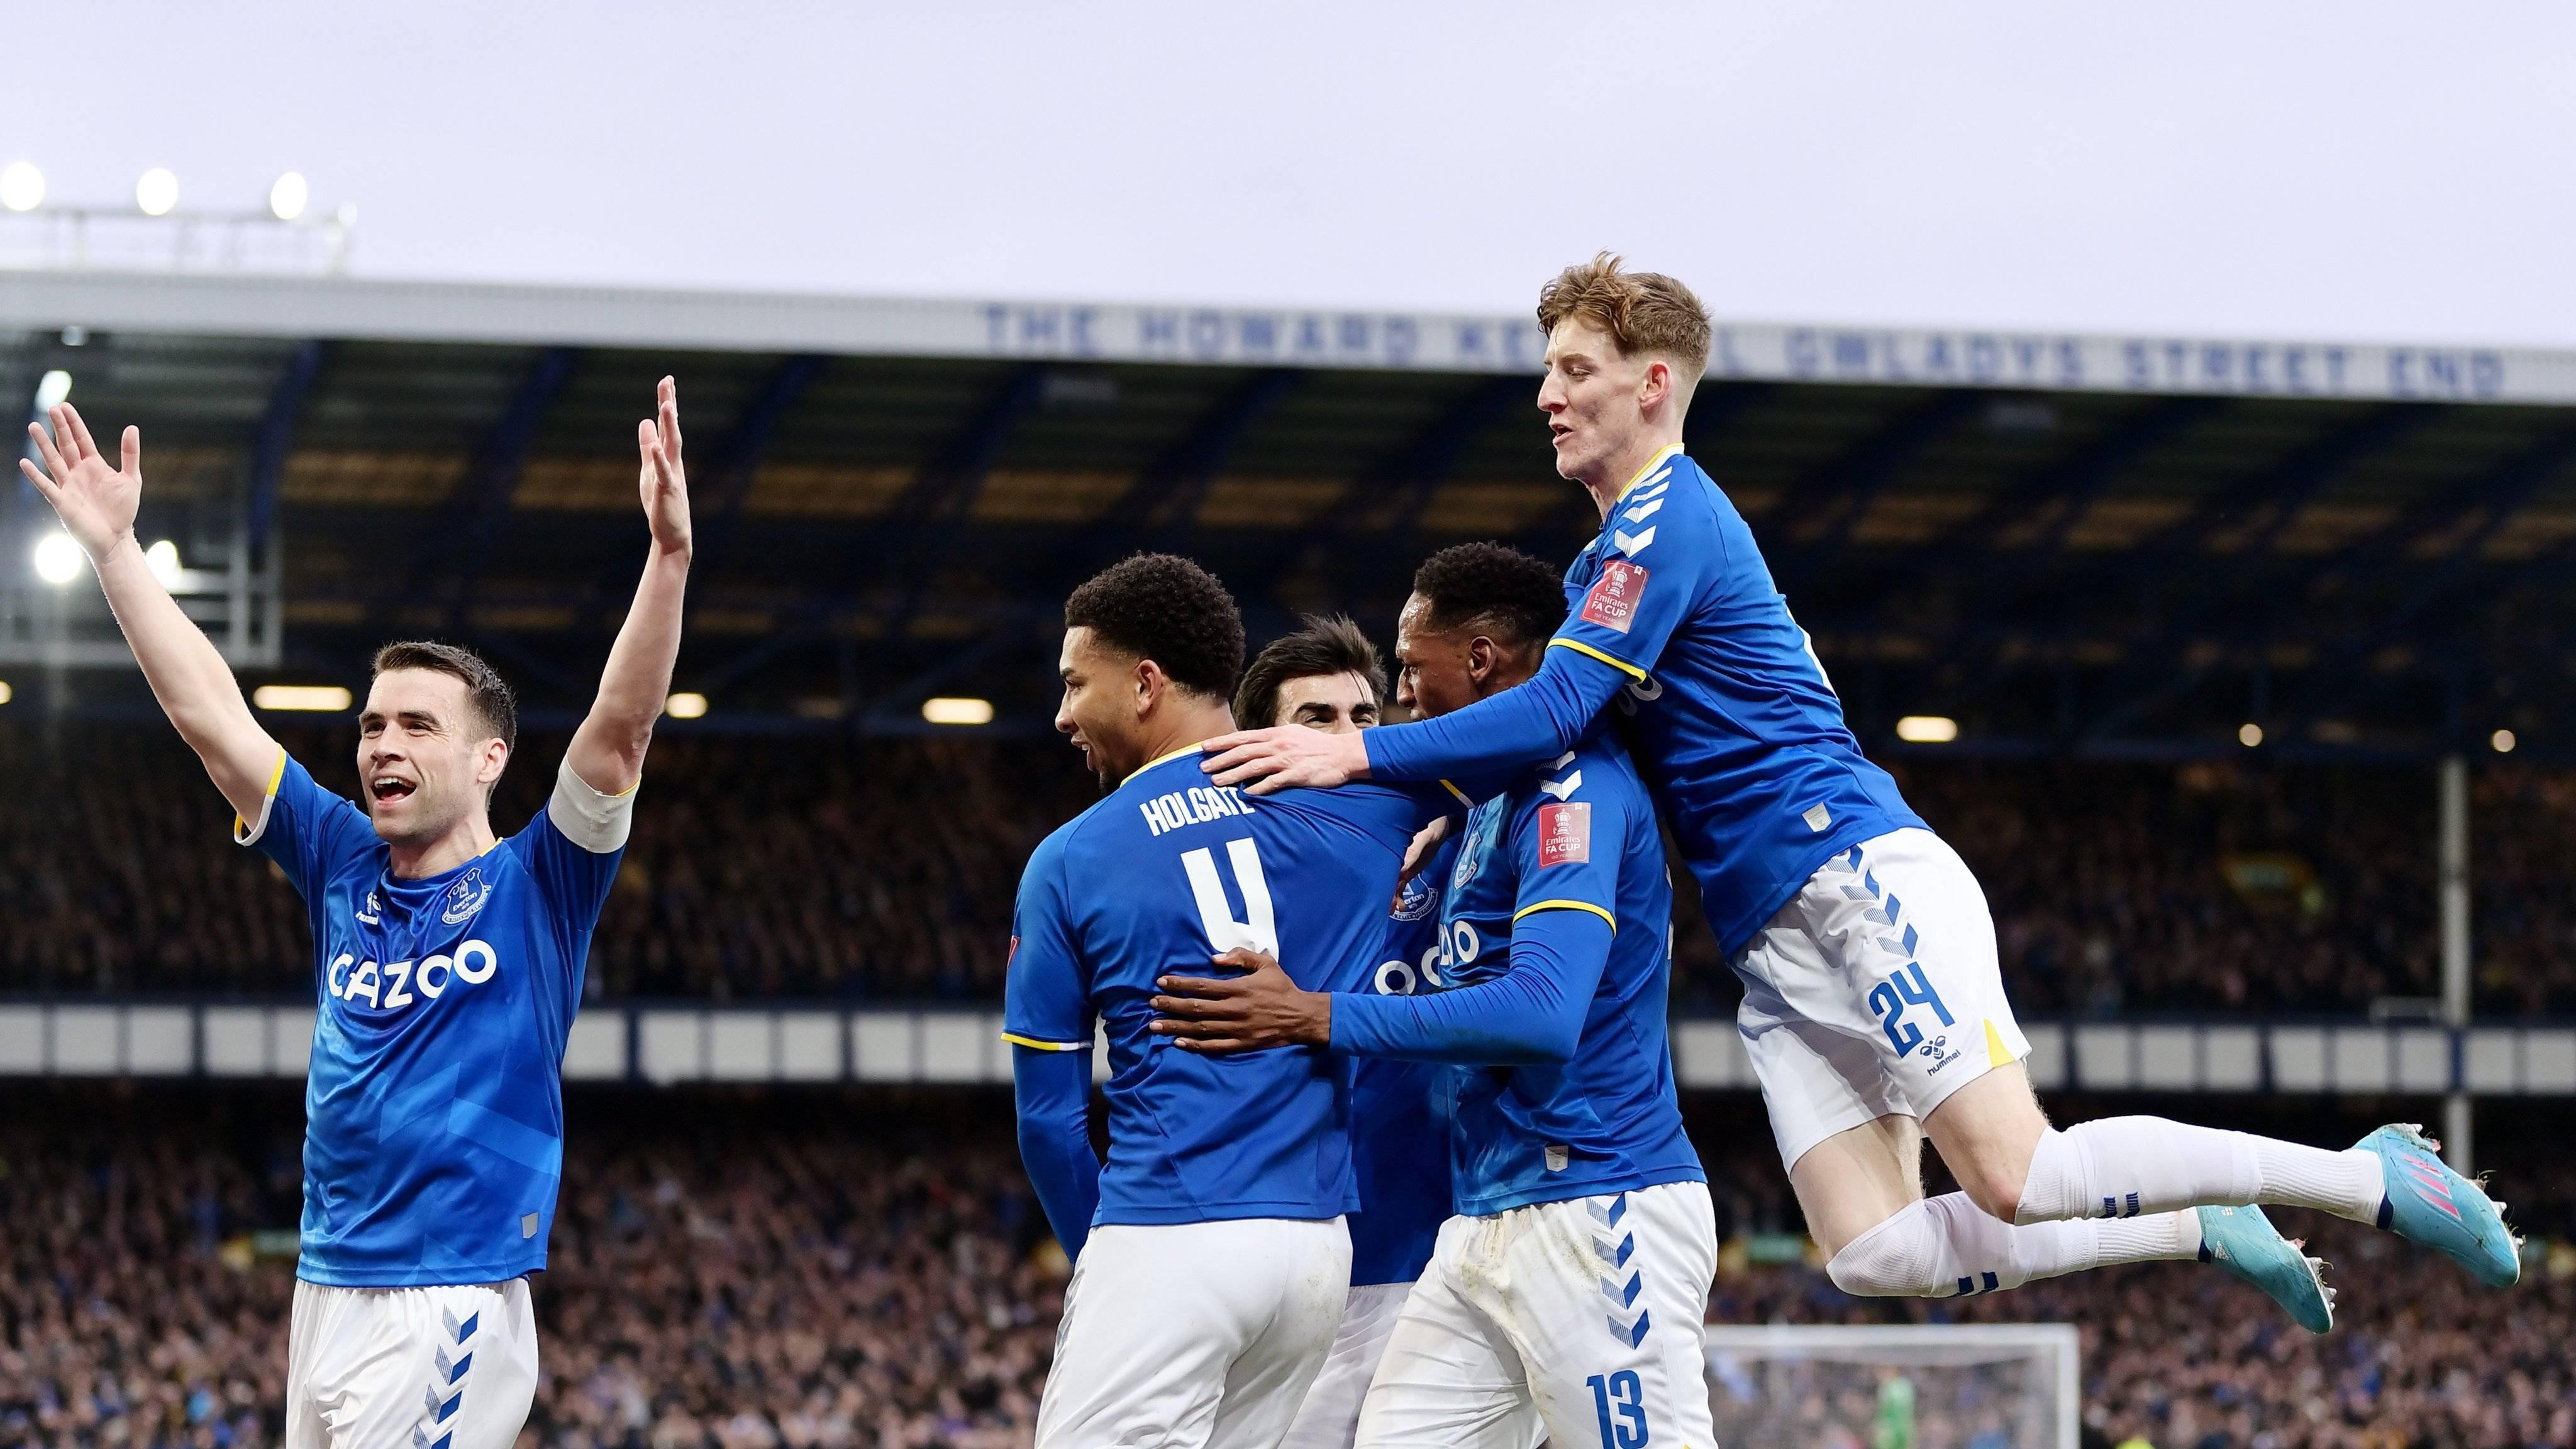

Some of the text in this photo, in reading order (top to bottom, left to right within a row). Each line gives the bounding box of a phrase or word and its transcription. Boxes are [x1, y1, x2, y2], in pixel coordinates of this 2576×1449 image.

[979, 305, 1101, 357] THE
[1137, 308, 1418, 367] HOWARD
[2124, 338, 2350, 395] STREET
[2392, 346, 2505, 400] END
[1591, 601, 1626, 618] FA CUP
[1594, 592, 1628, 610] Emirates
[1139, 785, 1255, 836] HOLGATE
[1545, 843, 1580, 855] FA CUP
[1546, 835, 1580, 846] Emirates
[1404, 894, 1424, 905] erton
[328, 939, 497, 1009] CAZOO
[1868, 961, 1956, 1058] 24
[1927, 1049, 1961, 1077] hummel
[1585, 1370, 1649, 1449] 13
